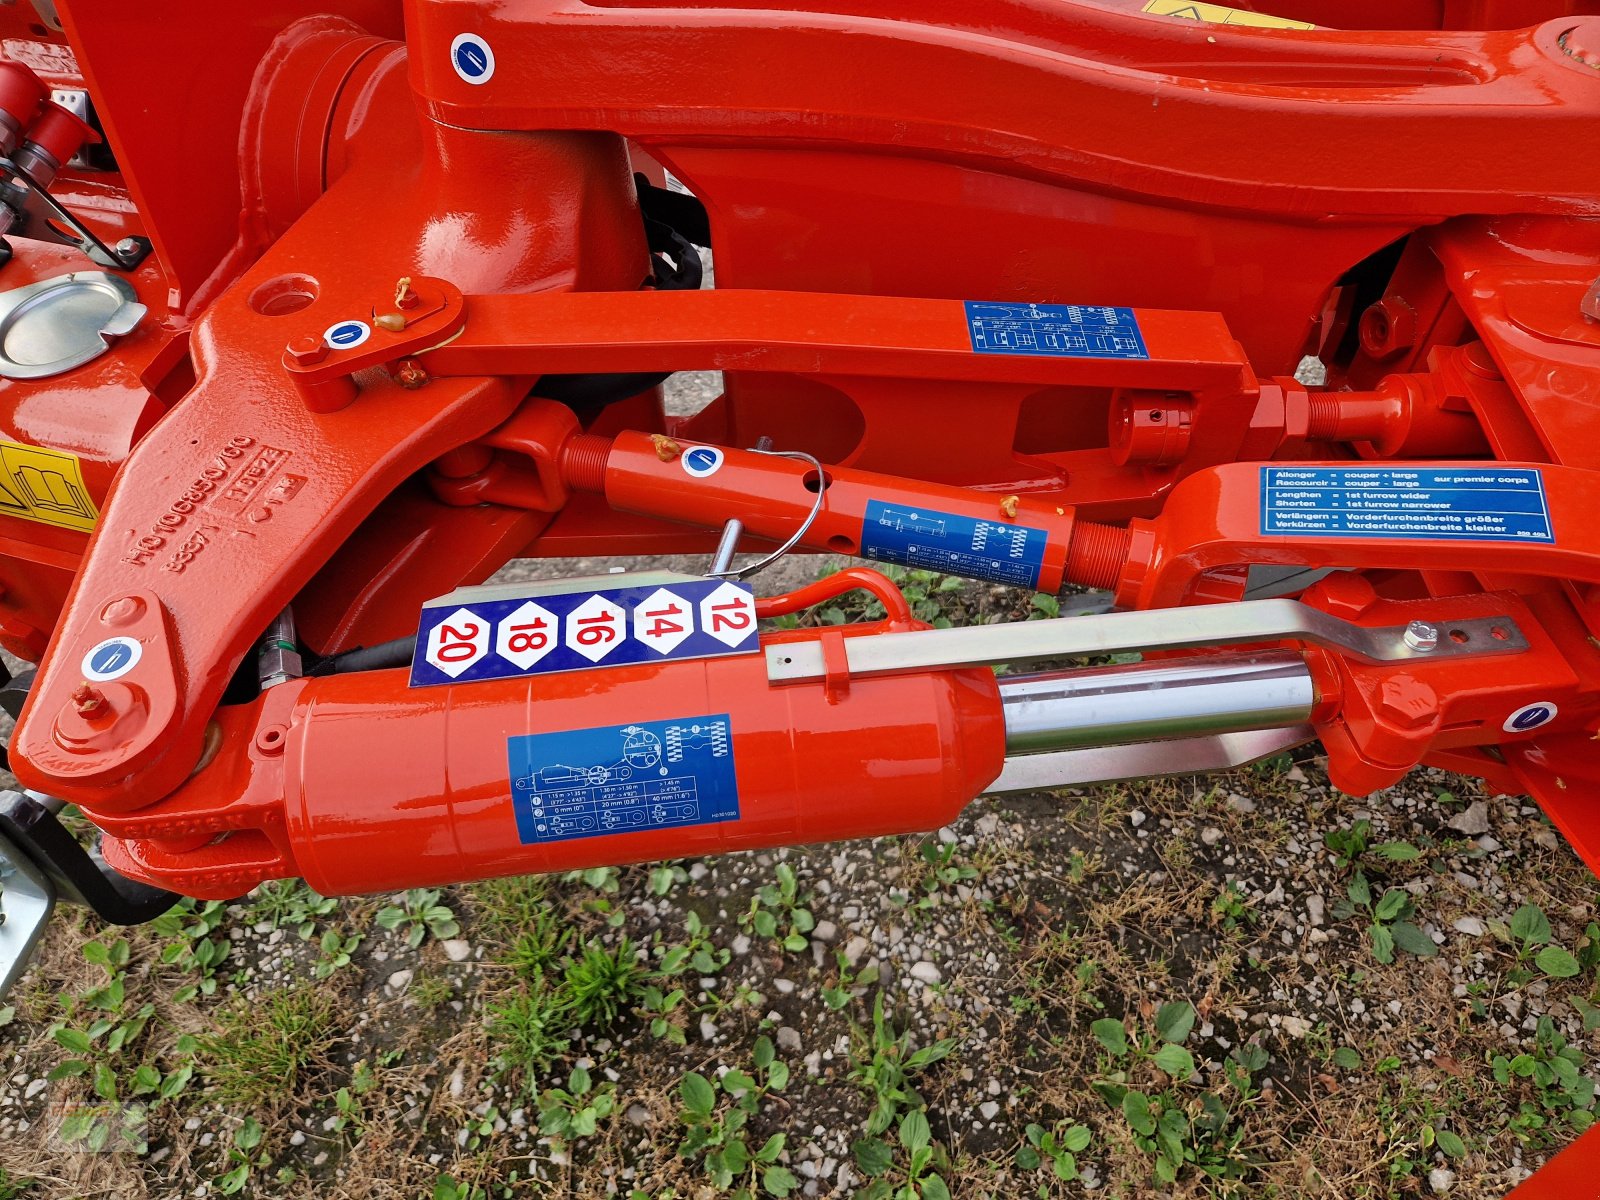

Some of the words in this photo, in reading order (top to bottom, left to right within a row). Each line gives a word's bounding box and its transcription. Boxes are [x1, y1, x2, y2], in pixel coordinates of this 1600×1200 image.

[1276, 471, 1316, 479] Allonger
[1453, 475, 1495, 483] premier
[1275, 491, 1321, 499] Lengthen
[1275, 512, 1329, 520] Verlängern
[1346, 513, 1461, 522] Vorderfurchenbreite
[1464, 515, 1504, 524] größer
[1347, 522, 1462, 531] Vorderfurchenbreite
[1465, 524, 1507, 532] kleiner
[645, 603, 682, 638] 14
[711, 597, 751, 632] 12
[508, 617, 548, 652] 18
[576, 610, 616, 646] 16
[437, 623, 479, 662] 20
